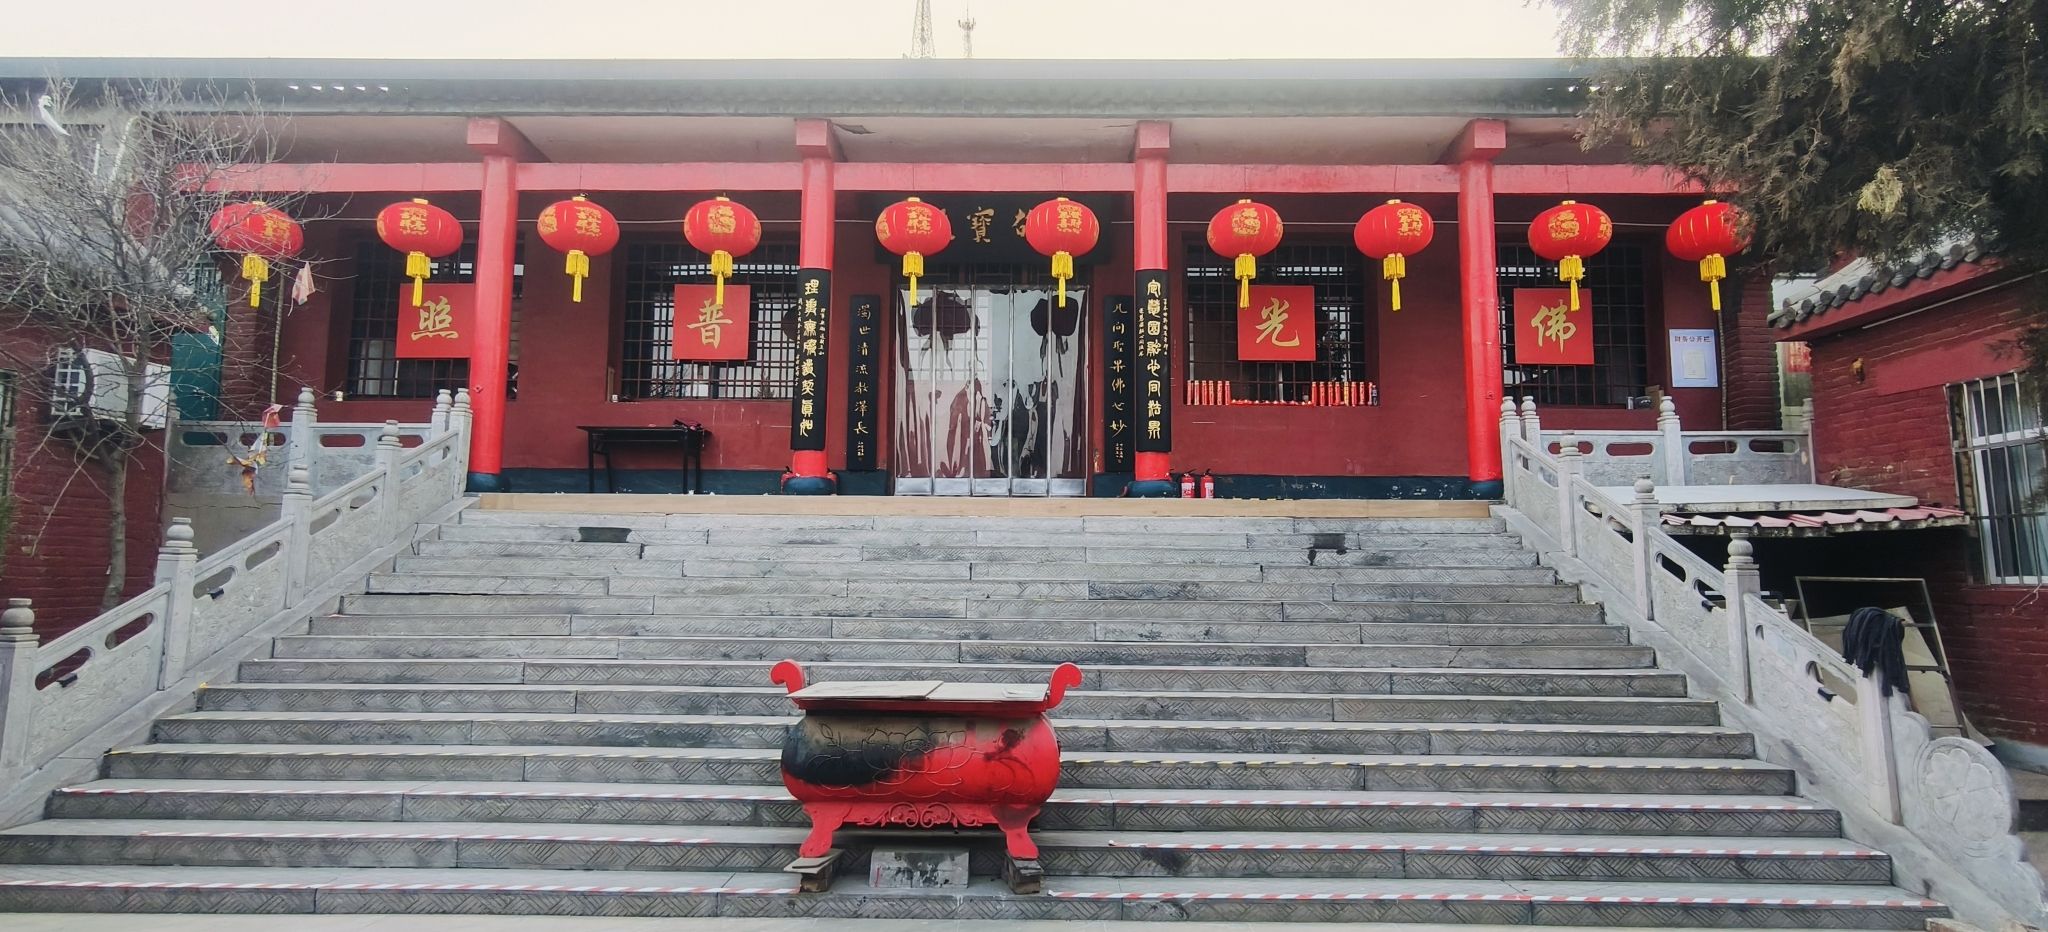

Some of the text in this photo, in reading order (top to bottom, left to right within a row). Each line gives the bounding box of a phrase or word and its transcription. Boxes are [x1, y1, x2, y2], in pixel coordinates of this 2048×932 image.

[411, 296, 459, 341] 照
[687, 298, 733, 349] 普
[1255, 297, 1301, 347] 光
[1530, 299, 1578, 354] 佛
